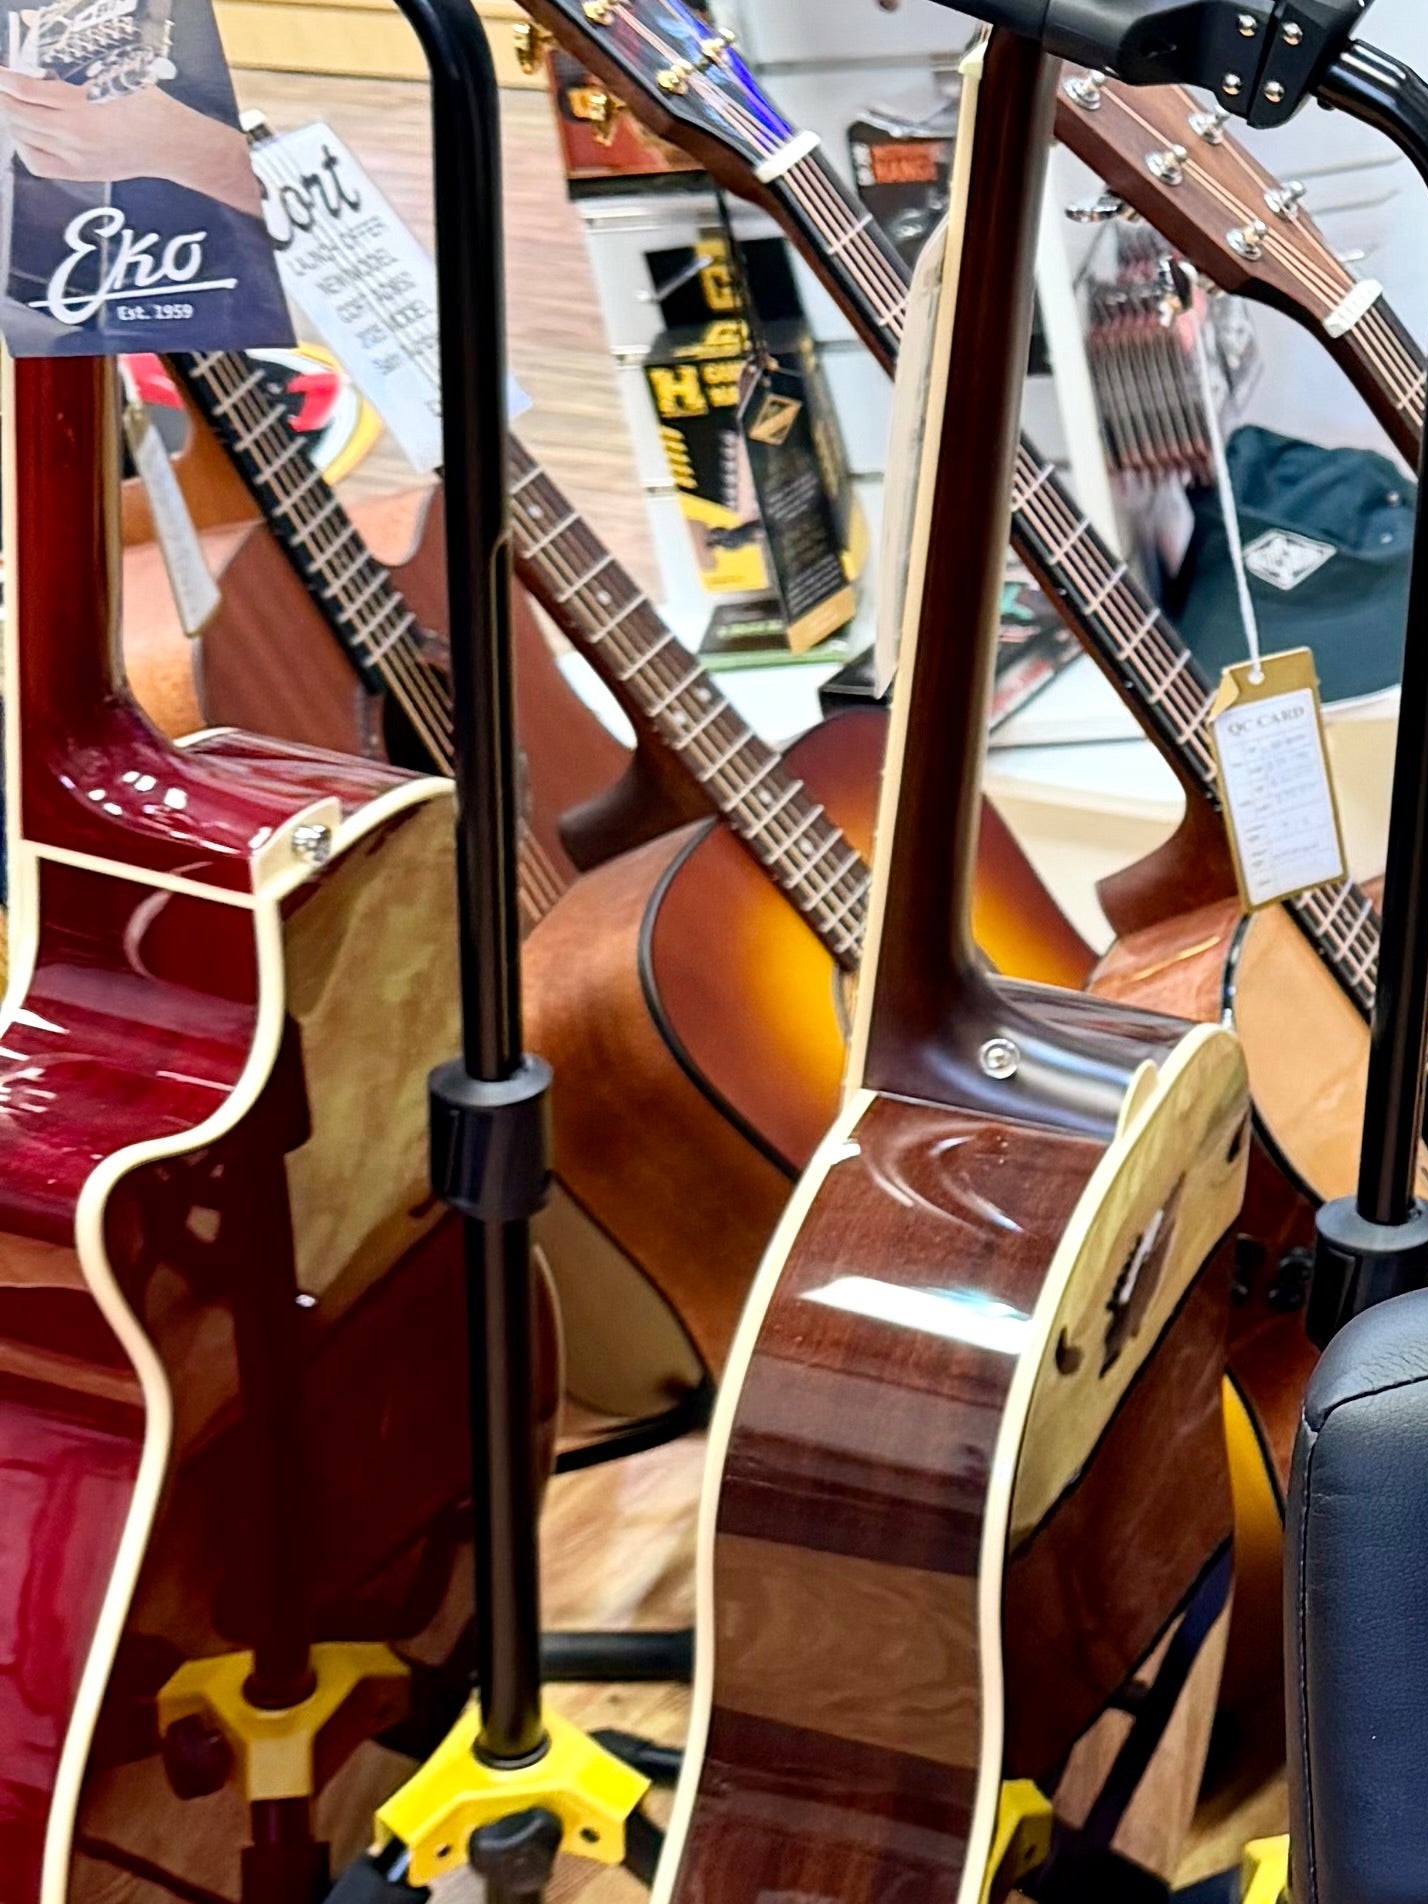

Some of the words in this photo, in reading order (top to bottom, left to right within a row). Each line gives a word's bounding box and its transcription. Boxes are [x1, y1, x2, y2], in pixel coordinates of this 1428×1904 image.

[42, 206, 214, 326] Eko
[117, 303, 150, 320] Est.
[154, 302, 194, 319] 1959
[1256, 706, 1305, 727] CARD
